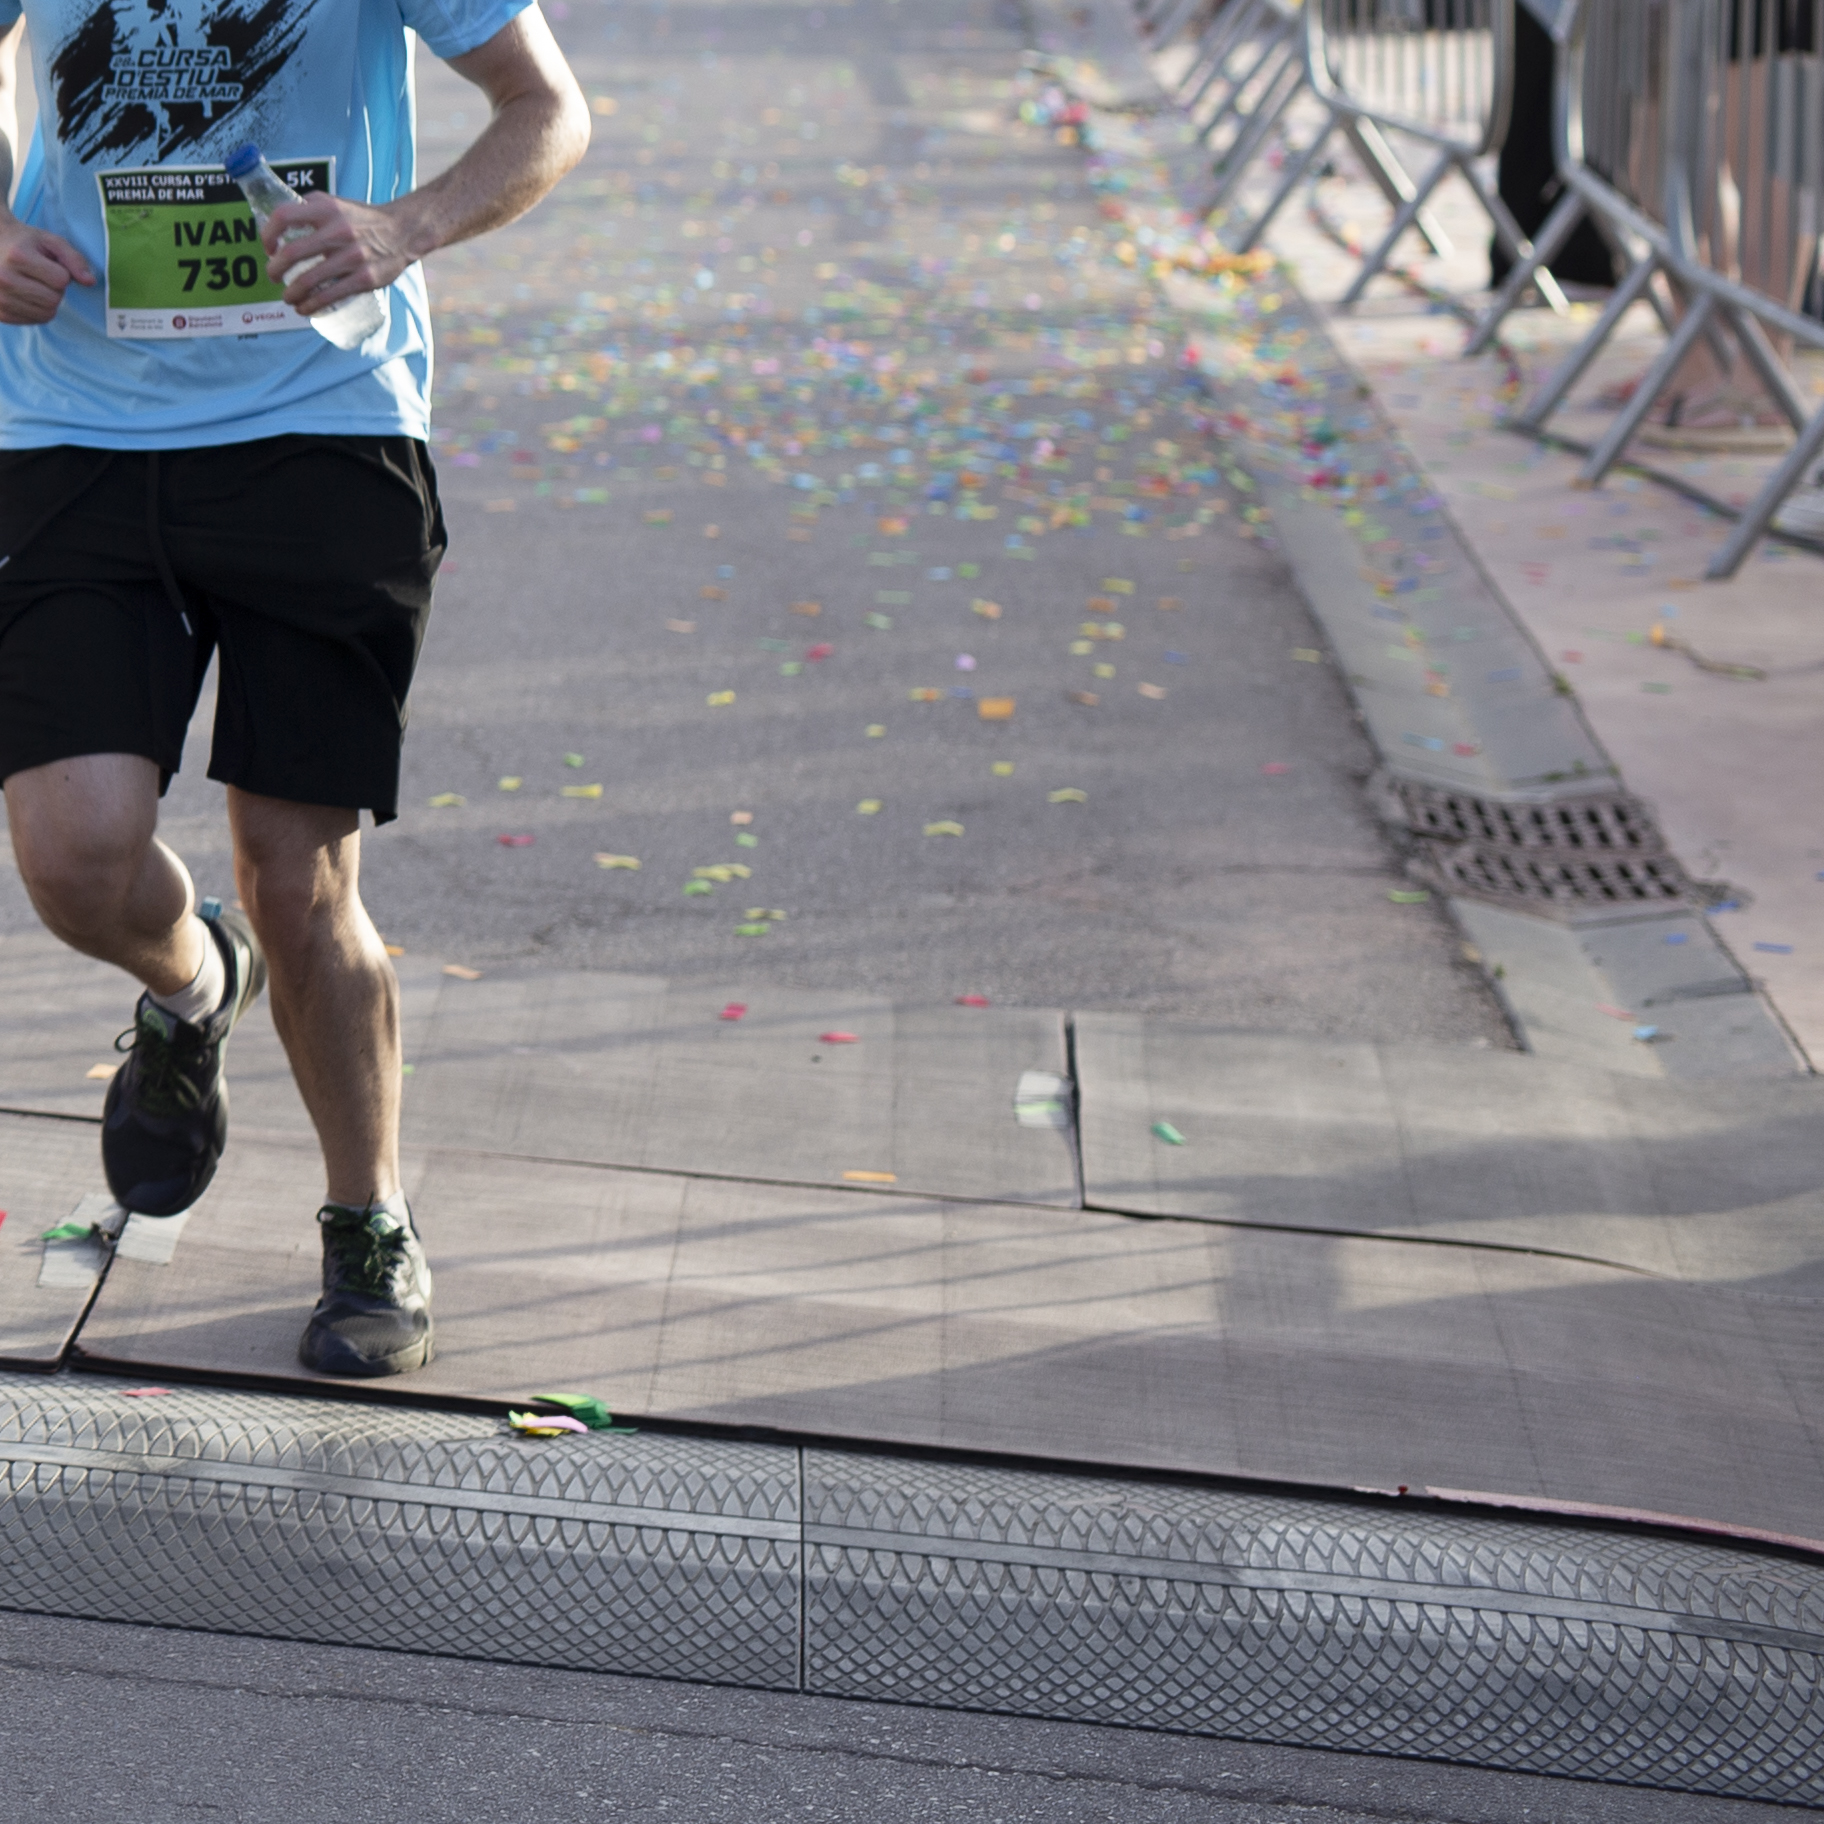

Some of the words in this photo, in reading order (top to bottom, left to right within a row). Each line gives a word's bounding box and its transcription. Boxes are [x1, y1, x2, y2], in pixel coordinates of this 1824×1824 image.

[137, 49, 228, 68] CURSA
[172, 86, 197, 99] DE
[201, 85, 240, 99] MAR
[151, 174, 191, 188] CURSA
[194, 173, 237, 185] D'EST
[286, 169, 315, 188] 5K
[107, 186, 154, 201] PREMIÀ
[158, 188, 173, 201] DE
[175, 188, 205, 200] MAR
[173, 218, 257, 247] IVAN
[178, 254, 259, 292] 730
